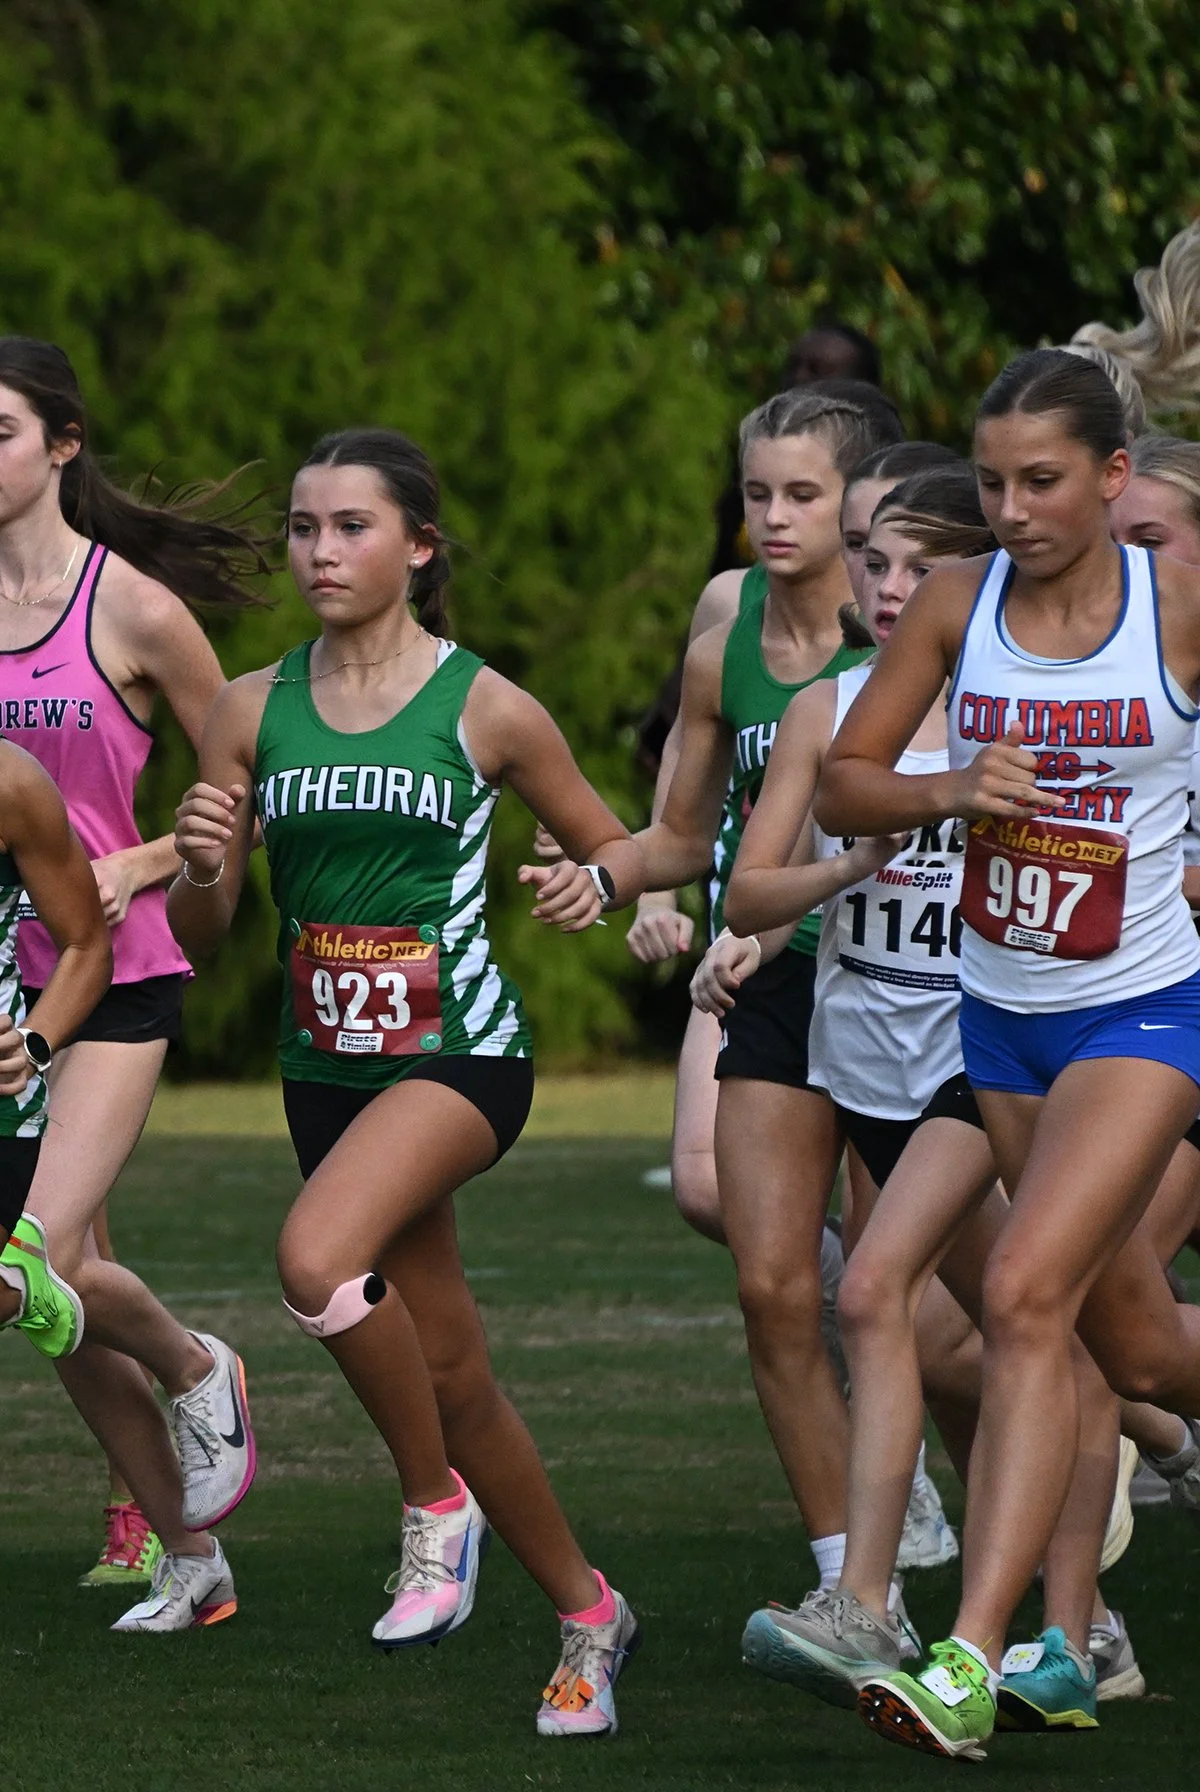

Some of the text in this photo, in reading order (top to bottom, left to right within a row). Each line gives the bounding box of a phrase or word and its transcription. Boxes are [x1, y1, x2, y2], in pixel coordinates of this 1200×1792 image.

[959, 691, 1154, 747] COLUMBIA
[875, 869, 953, 891] MileSplit
[987, 856, 1093, 932] 997
[312, 969, 411, 1030] 923
